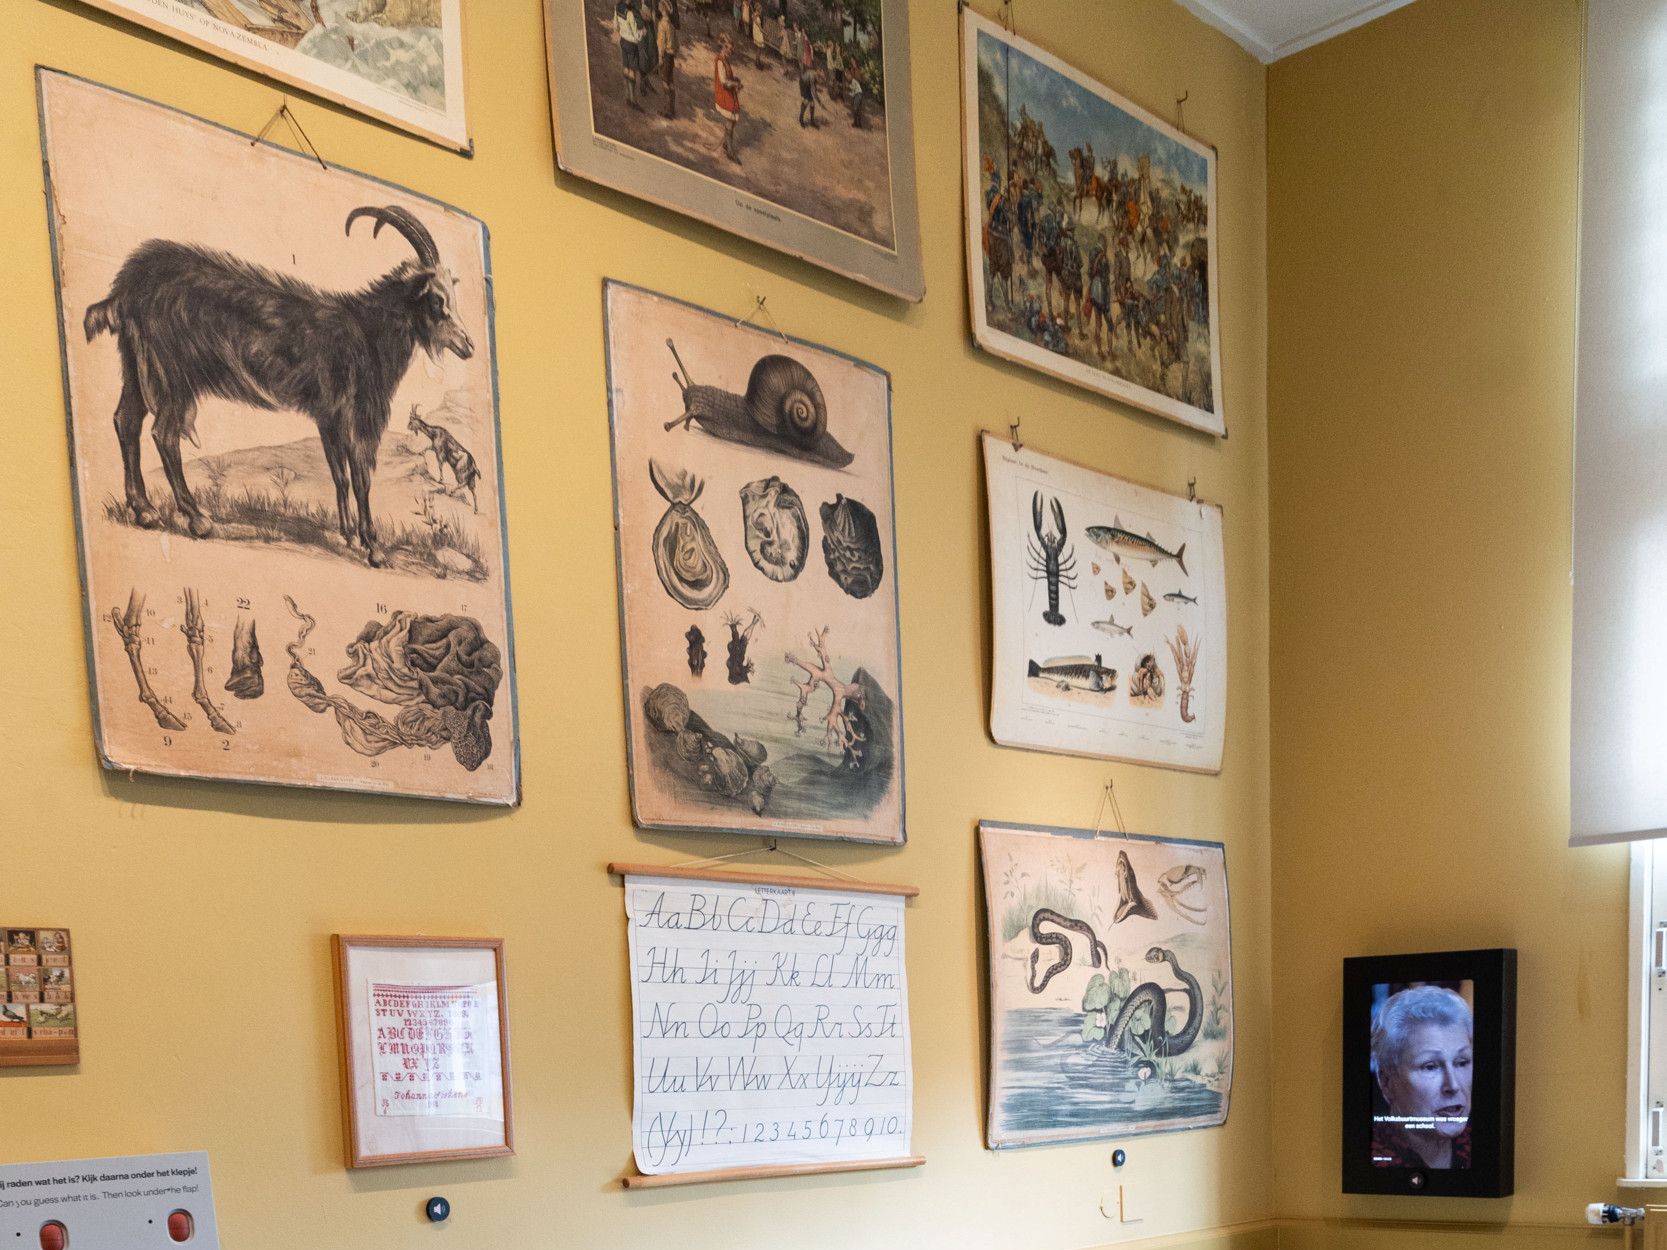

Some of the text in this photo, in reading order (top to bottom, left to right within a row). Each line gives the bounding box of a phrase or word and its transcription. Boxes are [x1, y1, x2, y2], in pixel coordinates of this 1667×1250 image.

[236, 597, 251, 610] 22
[376, 602, 388, 615] 16
[163, 735, 172, 747] 9
[221, 739, 231, 751] 2
[6, 1179, 33, 1189] raden
[34, 1178, 51, 1187] wat
[52, 1176, 67, 1185] het
[68, 1174, 80, 1184] is?
[81, 1174, 98, 1184] Kijk
[99, 1172, 130, 1182] daarna
[130, 1170, 155, 1179] onder
[156, 1168, 171, 1178] het
[170, 1166, 198, 1177] klepje!
[33, 1196, 60, 1208] guess
[60, 1194, 82, 1203] what
[82, 1193, 89, 1201] it
[102, 1190, 124, 1200] Then
[124, 1188, 142, 1198] look
[143, 1187, 167, 1197] under
[182, 1184, 200, 1196] flap!
